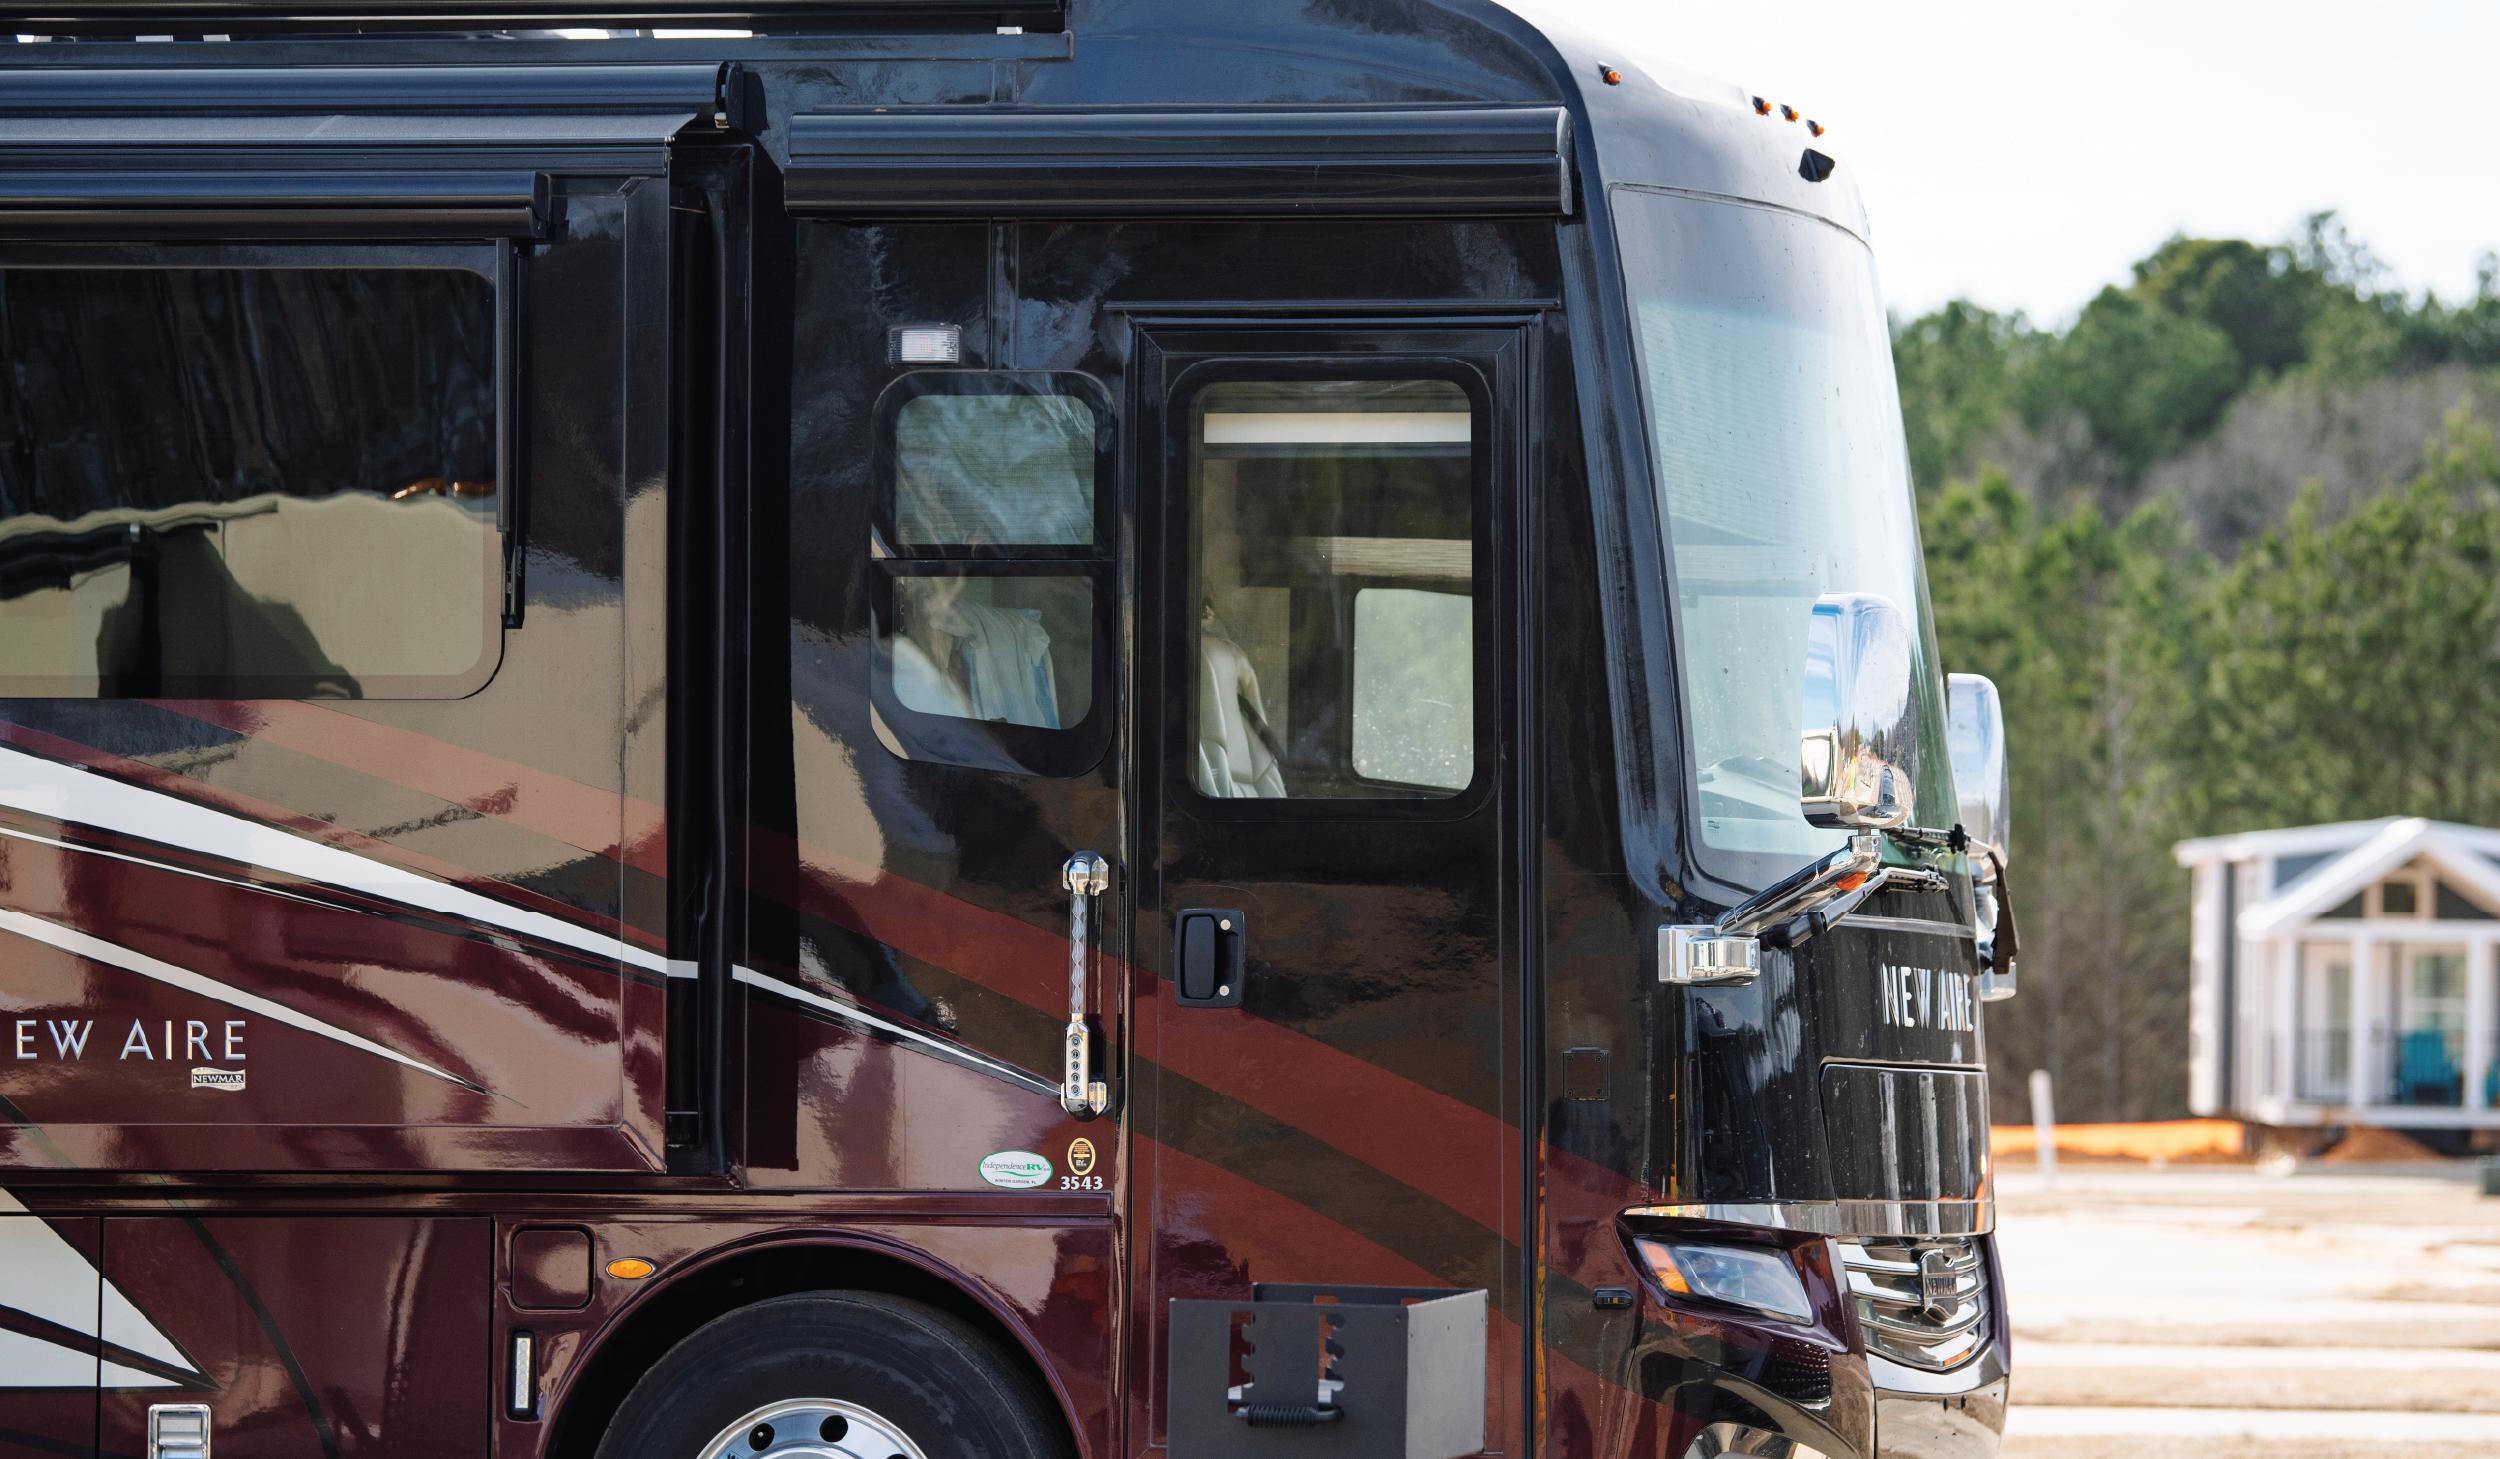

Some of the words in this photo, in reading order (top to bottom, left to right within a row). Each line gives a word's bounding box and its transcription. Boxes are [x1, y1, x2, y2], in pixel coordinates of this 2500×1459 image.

[1881, 962, 1931, 1030] NEW
[1938, 969, 1974, 1032] AIRE
[119, 1018, 246, 1060] AIRE
[193, 1074, 244, 1084] NEWMAR
[1060, 1175, 1104, 1190] 3543
